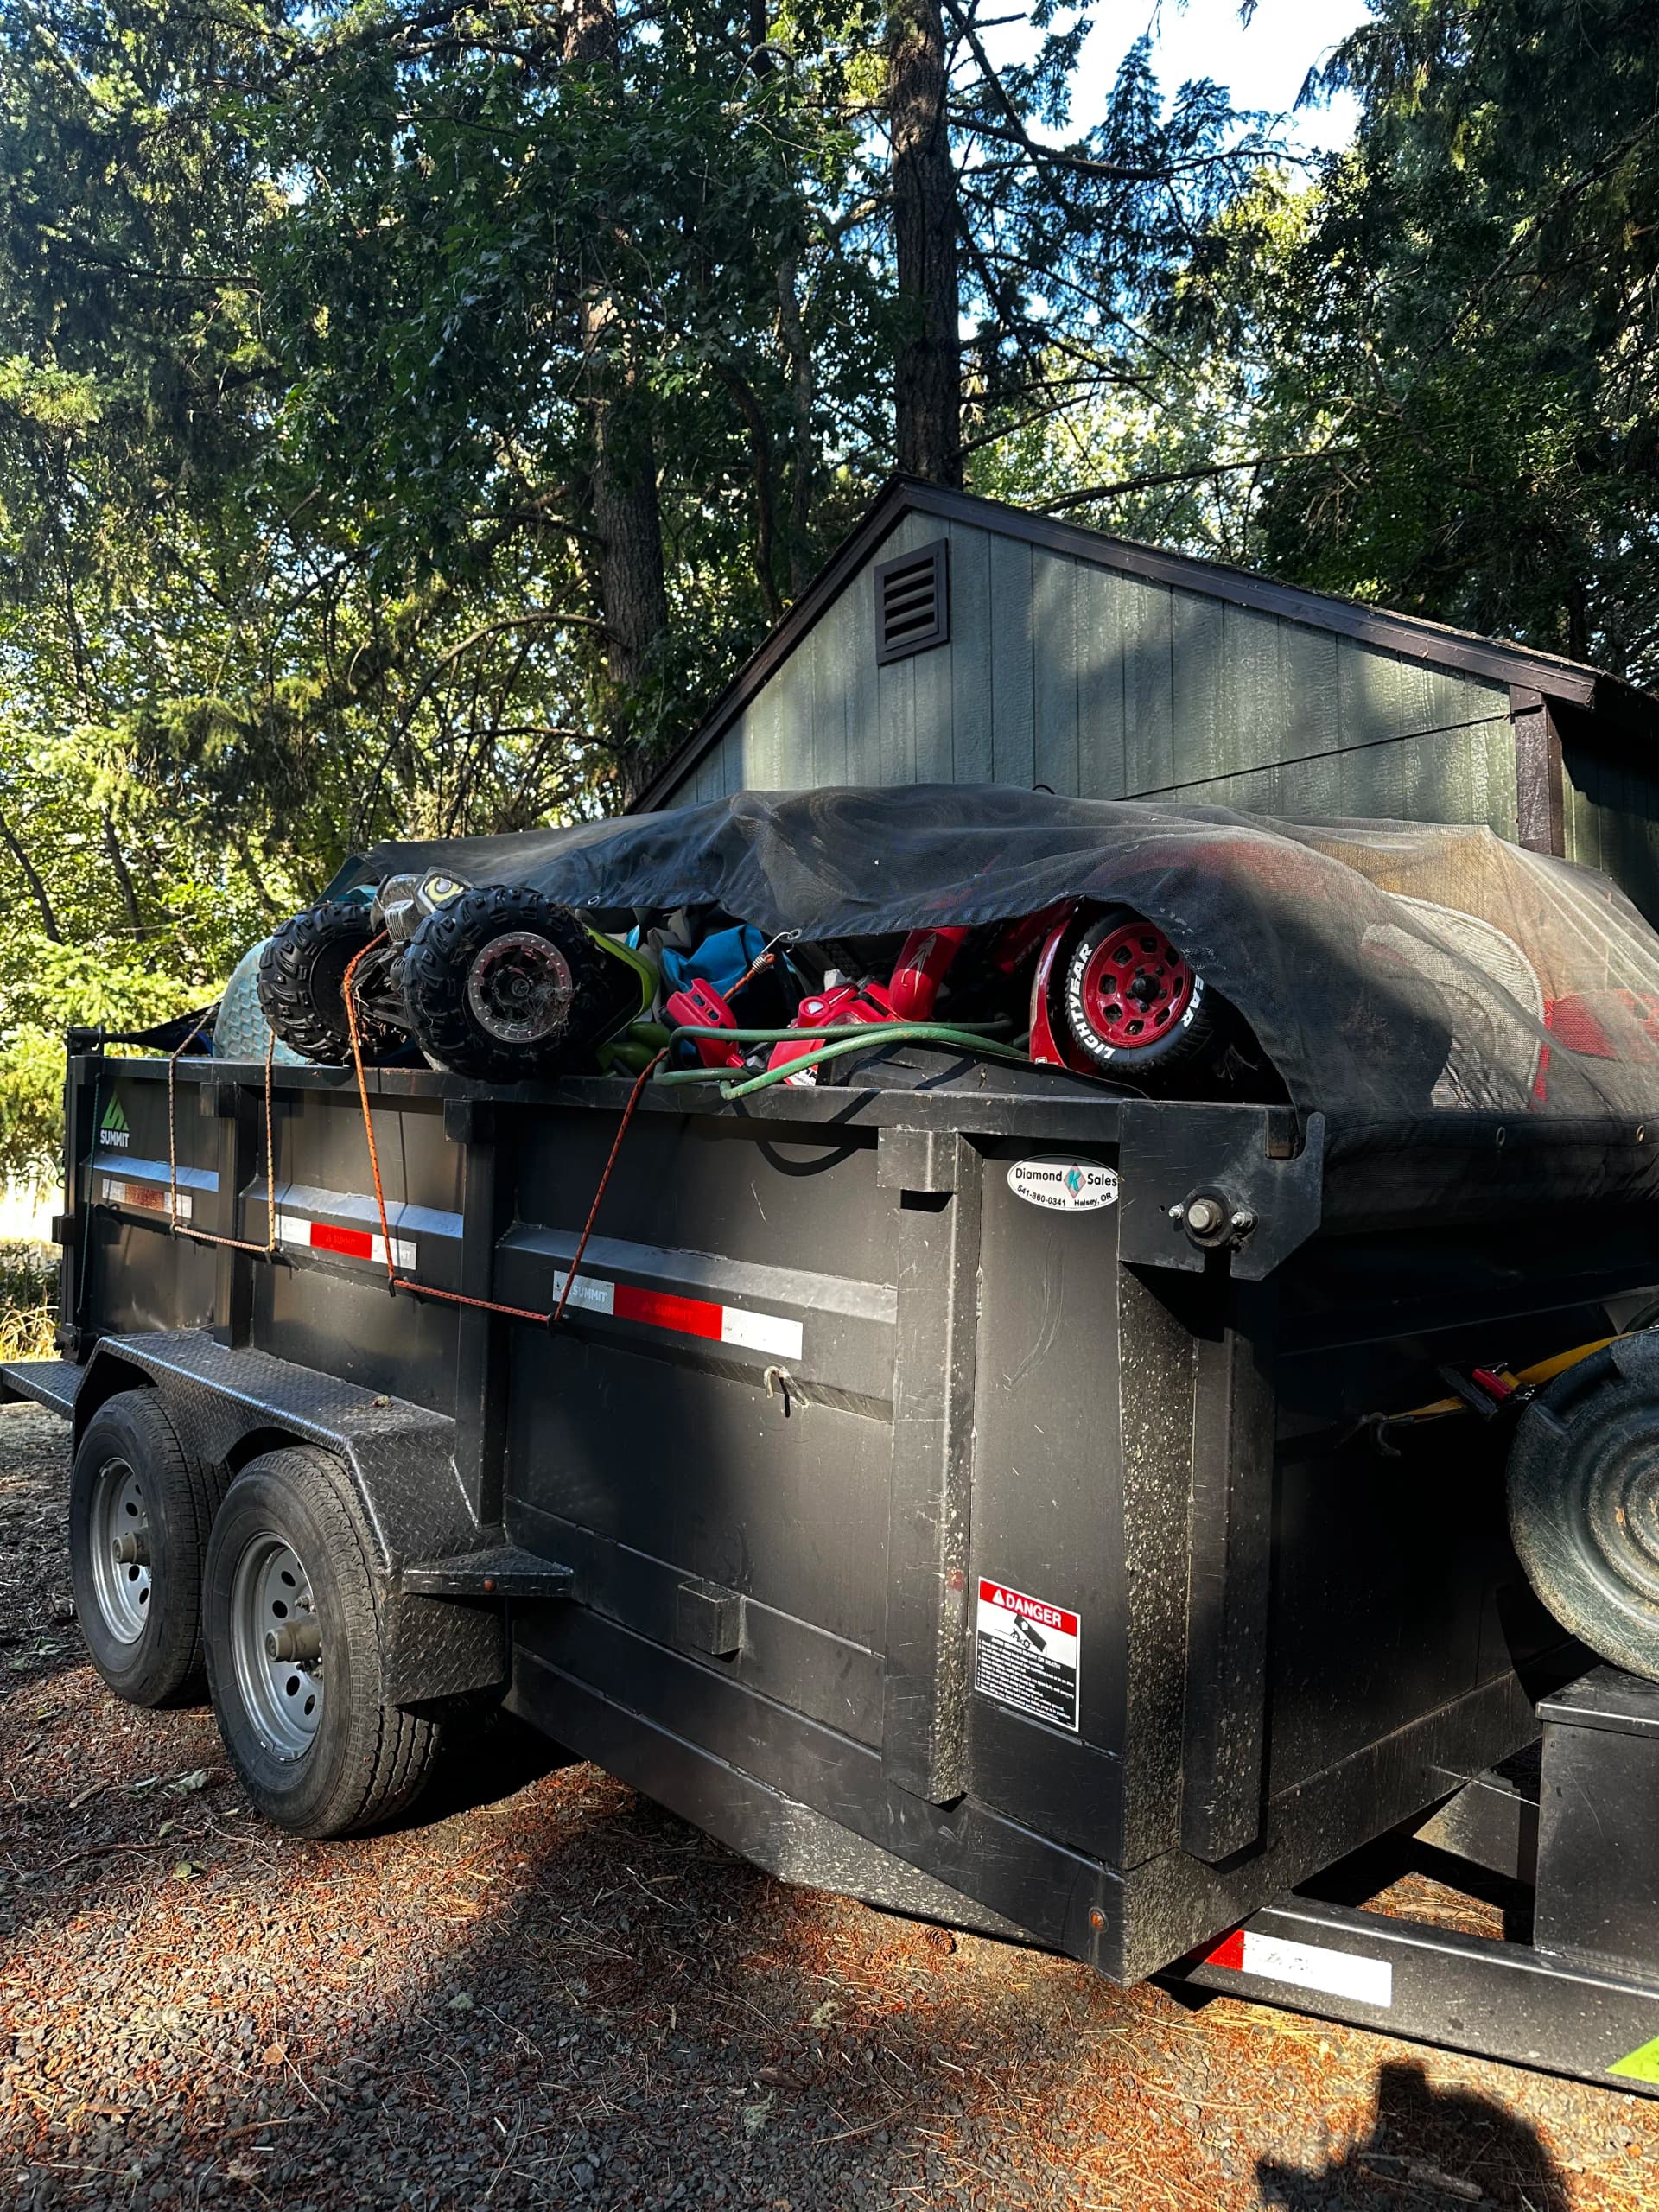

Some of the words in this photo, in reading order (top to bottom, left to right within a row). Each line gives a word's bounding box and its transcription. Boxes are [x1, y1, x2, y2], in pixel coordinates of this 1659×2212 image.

[1068, 943, 1116, 1059] LIGHTYEAR
[99, 1129, 130, 1148] SUMMIT
[1015, 1167, 1063, 1182] Diamond
[1087, 1173, 1117, 1187] Sales
[1074, 1197, 1100, 1207] Halsey,
[1100, 1192, 1113, 1202] OR
[572, 1285, 607, 1302] SUMMIT
[1006, 1593, 1062, 1629] DANGER
